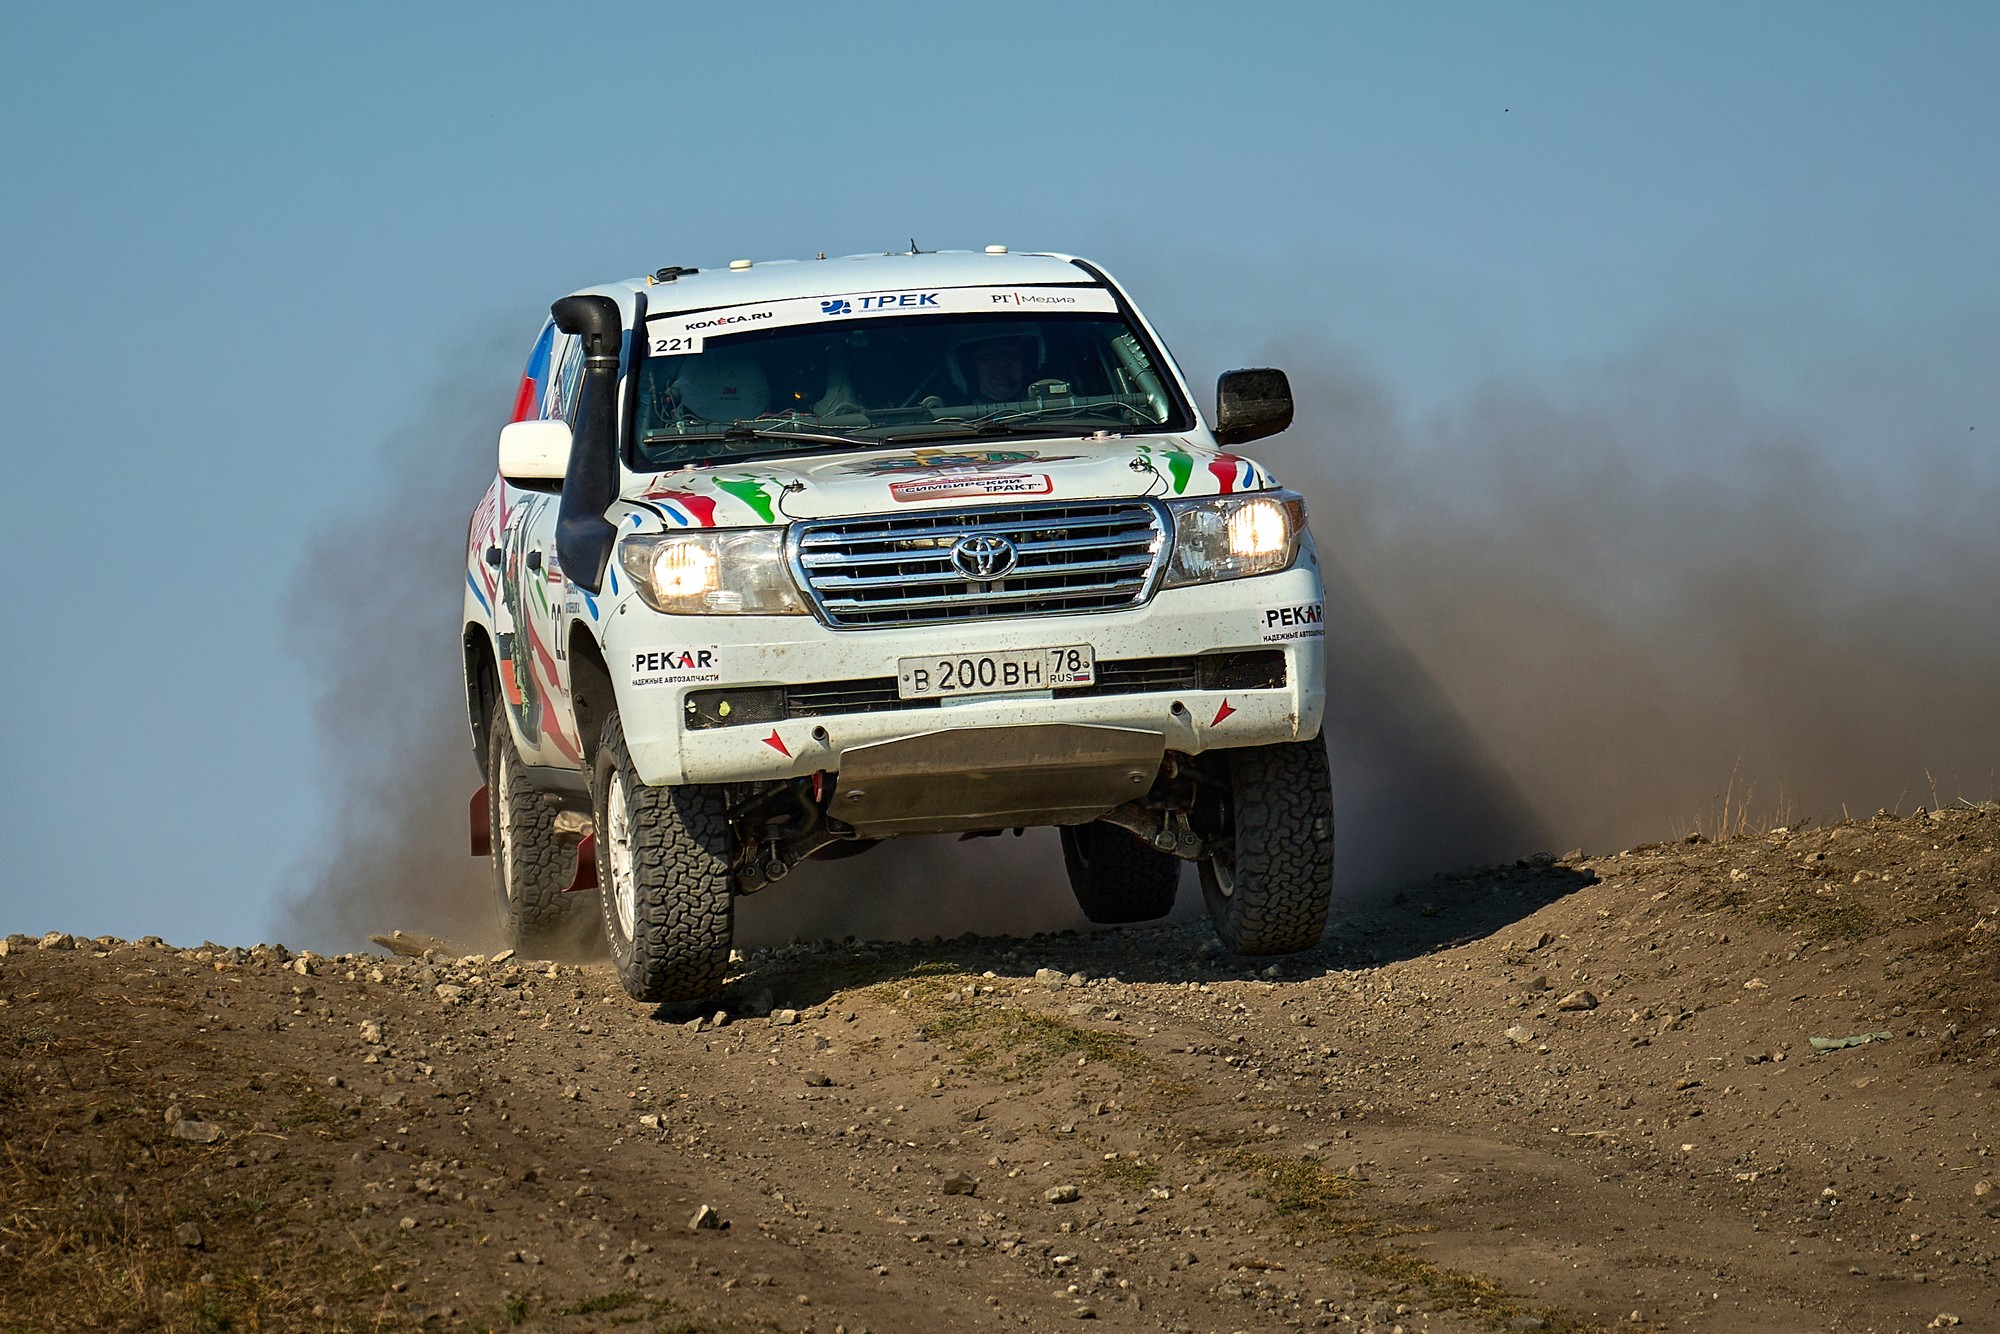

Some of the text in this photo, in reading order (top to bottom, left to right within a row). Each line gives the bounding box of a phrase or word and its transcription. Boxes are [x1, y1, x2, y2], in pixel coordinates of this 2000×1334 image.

[858, 293, 939, 308] ТРЕК
[656, 338, 692, 352] 221
[1265, 605, 1322, 628] PEKAR
[1263, 632, 1299, 642] НАДЕЖНЫЕ
[636, 650, 712, 672] PEKAR
[1052, 650, 1081, 672] 78
[632, 675, 719, 686] НАДЕЖНЫЕ АВТОЗАПЧАСТИ
[1050, 673, 1073, 683] RUS
